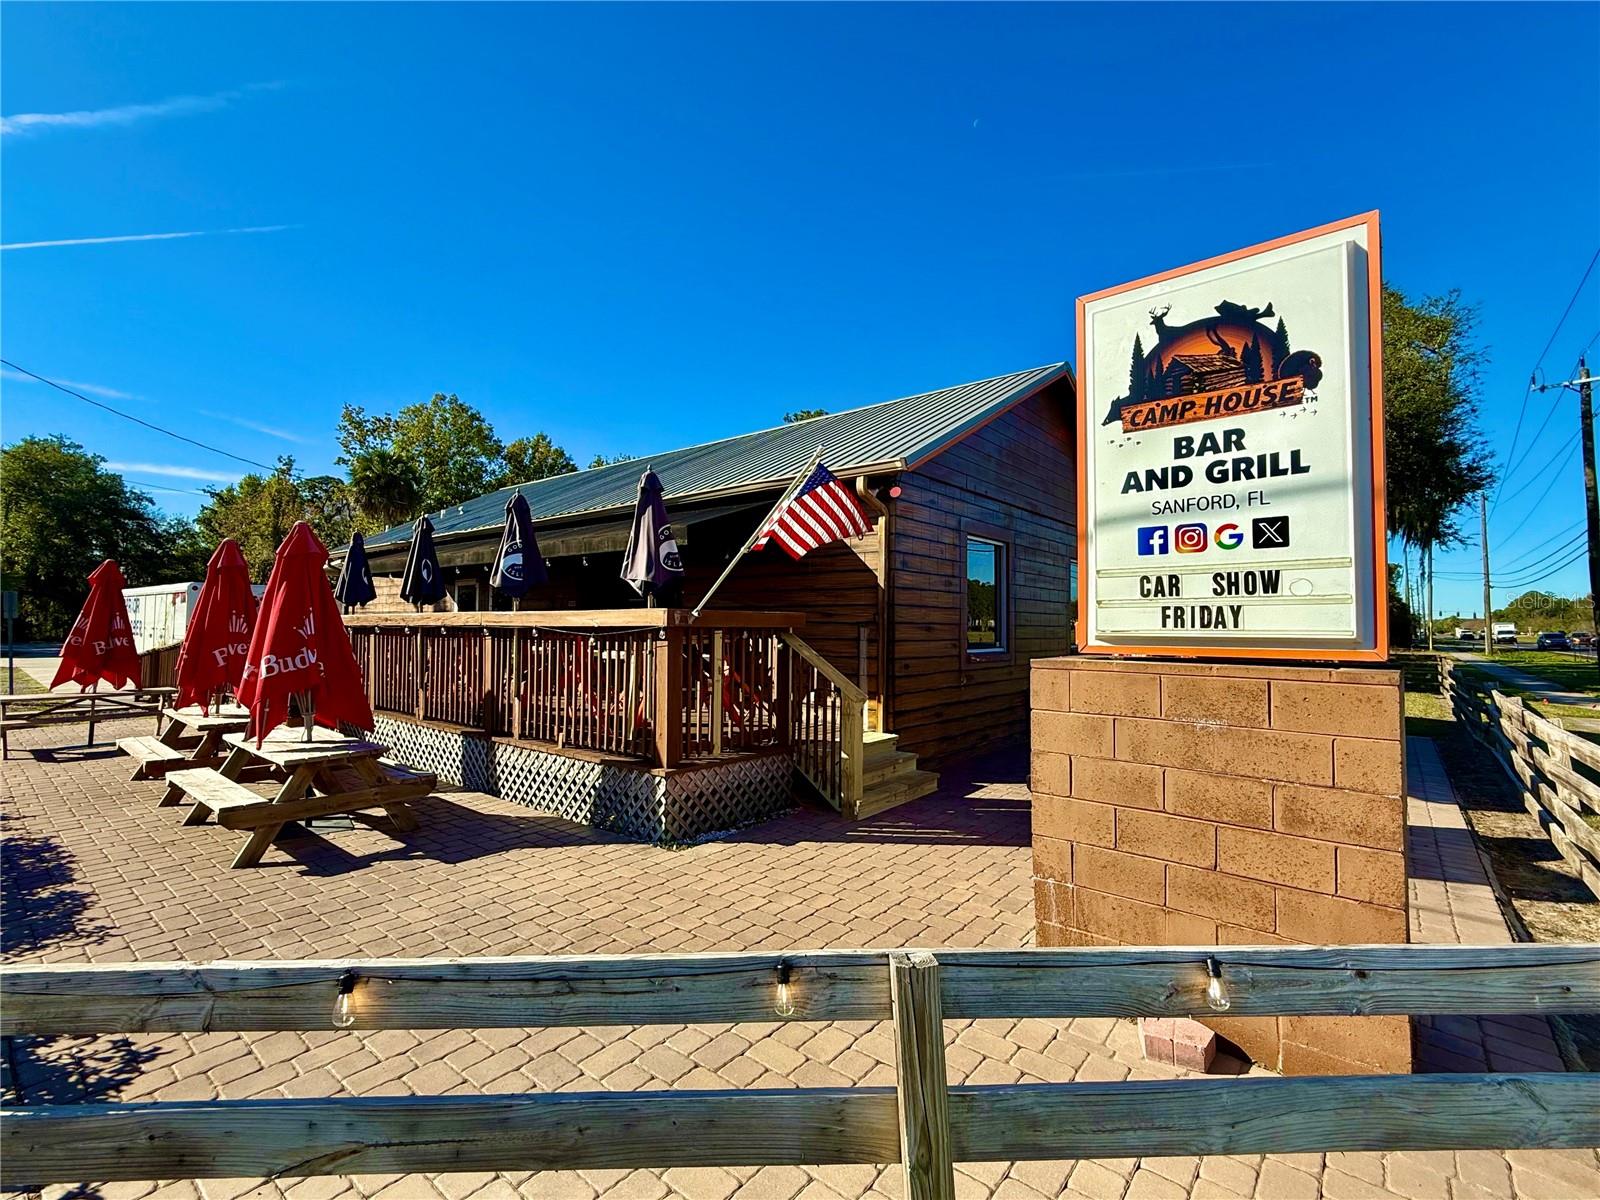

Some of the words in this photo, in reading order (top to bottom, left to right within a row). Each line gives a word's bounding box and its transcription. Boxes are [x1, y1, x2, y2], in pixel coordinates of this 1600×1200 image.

[1129, 402, 1196, 427] CAMP
[1204, 381, 1298, 416] HOUSE
[1173, 427, 1246, 460] BAR
[1120, 464, 1193, 495] AND
[1205, 448, 1311, 484] GRILL
[1151, 493, 1240, 516] SANFORD,
[1248, 490, 1271, 507] FL
[1139, 574, 1181, 598] CAR
[1212, 569, 1281, 597] SHOW
[1161, 605, 1242, 629] FRIDAY
